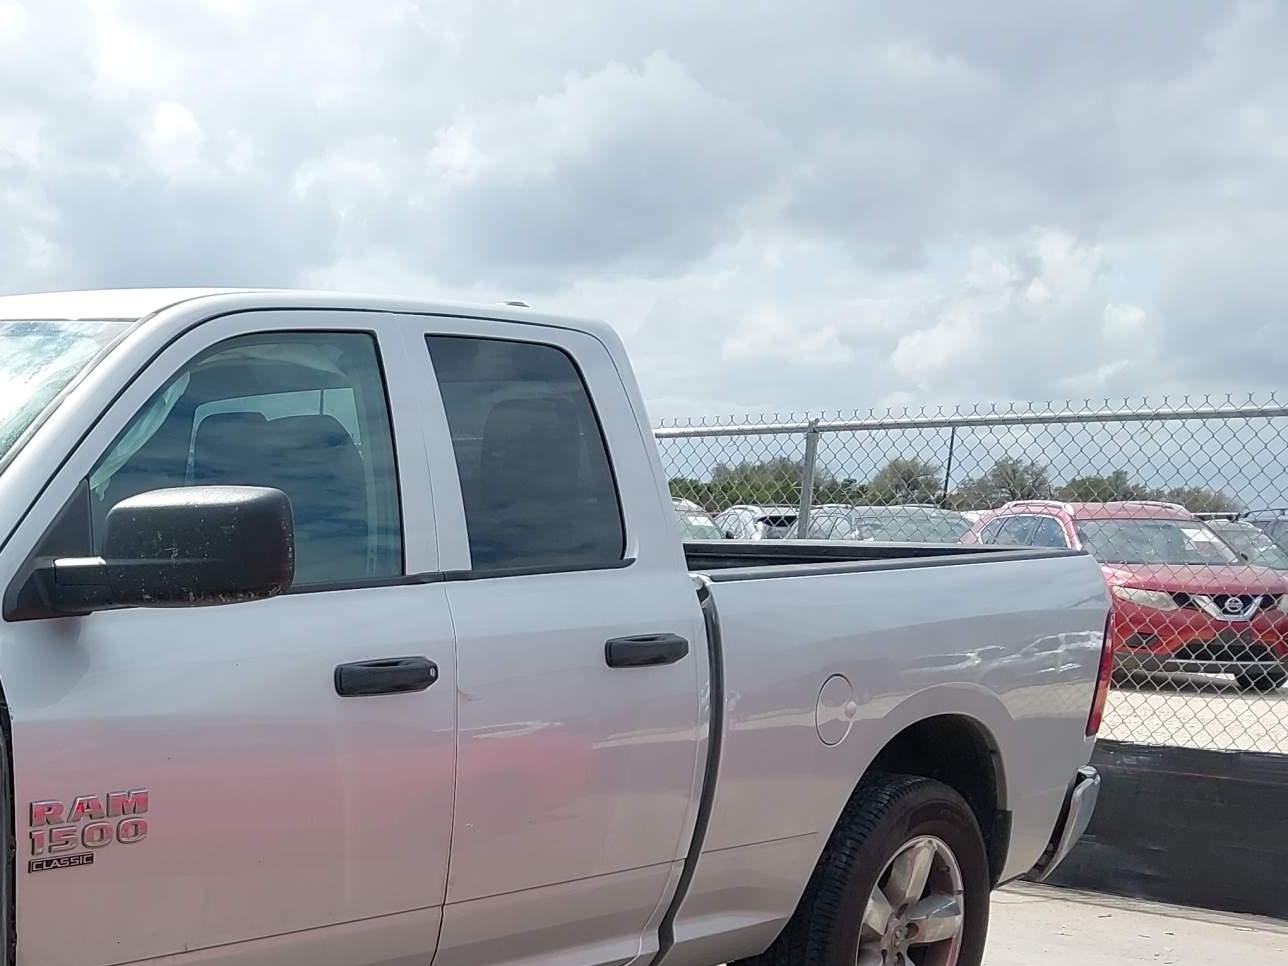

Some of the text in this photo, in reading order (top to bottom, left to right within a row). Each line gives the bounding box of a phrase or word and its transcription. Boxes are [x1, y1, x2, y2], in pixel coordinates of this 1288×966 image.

[29, 788, 149, 827] RAM
[29, 816, 149, 856] 1500
[32, 854, 93, 871] CLASSIC
